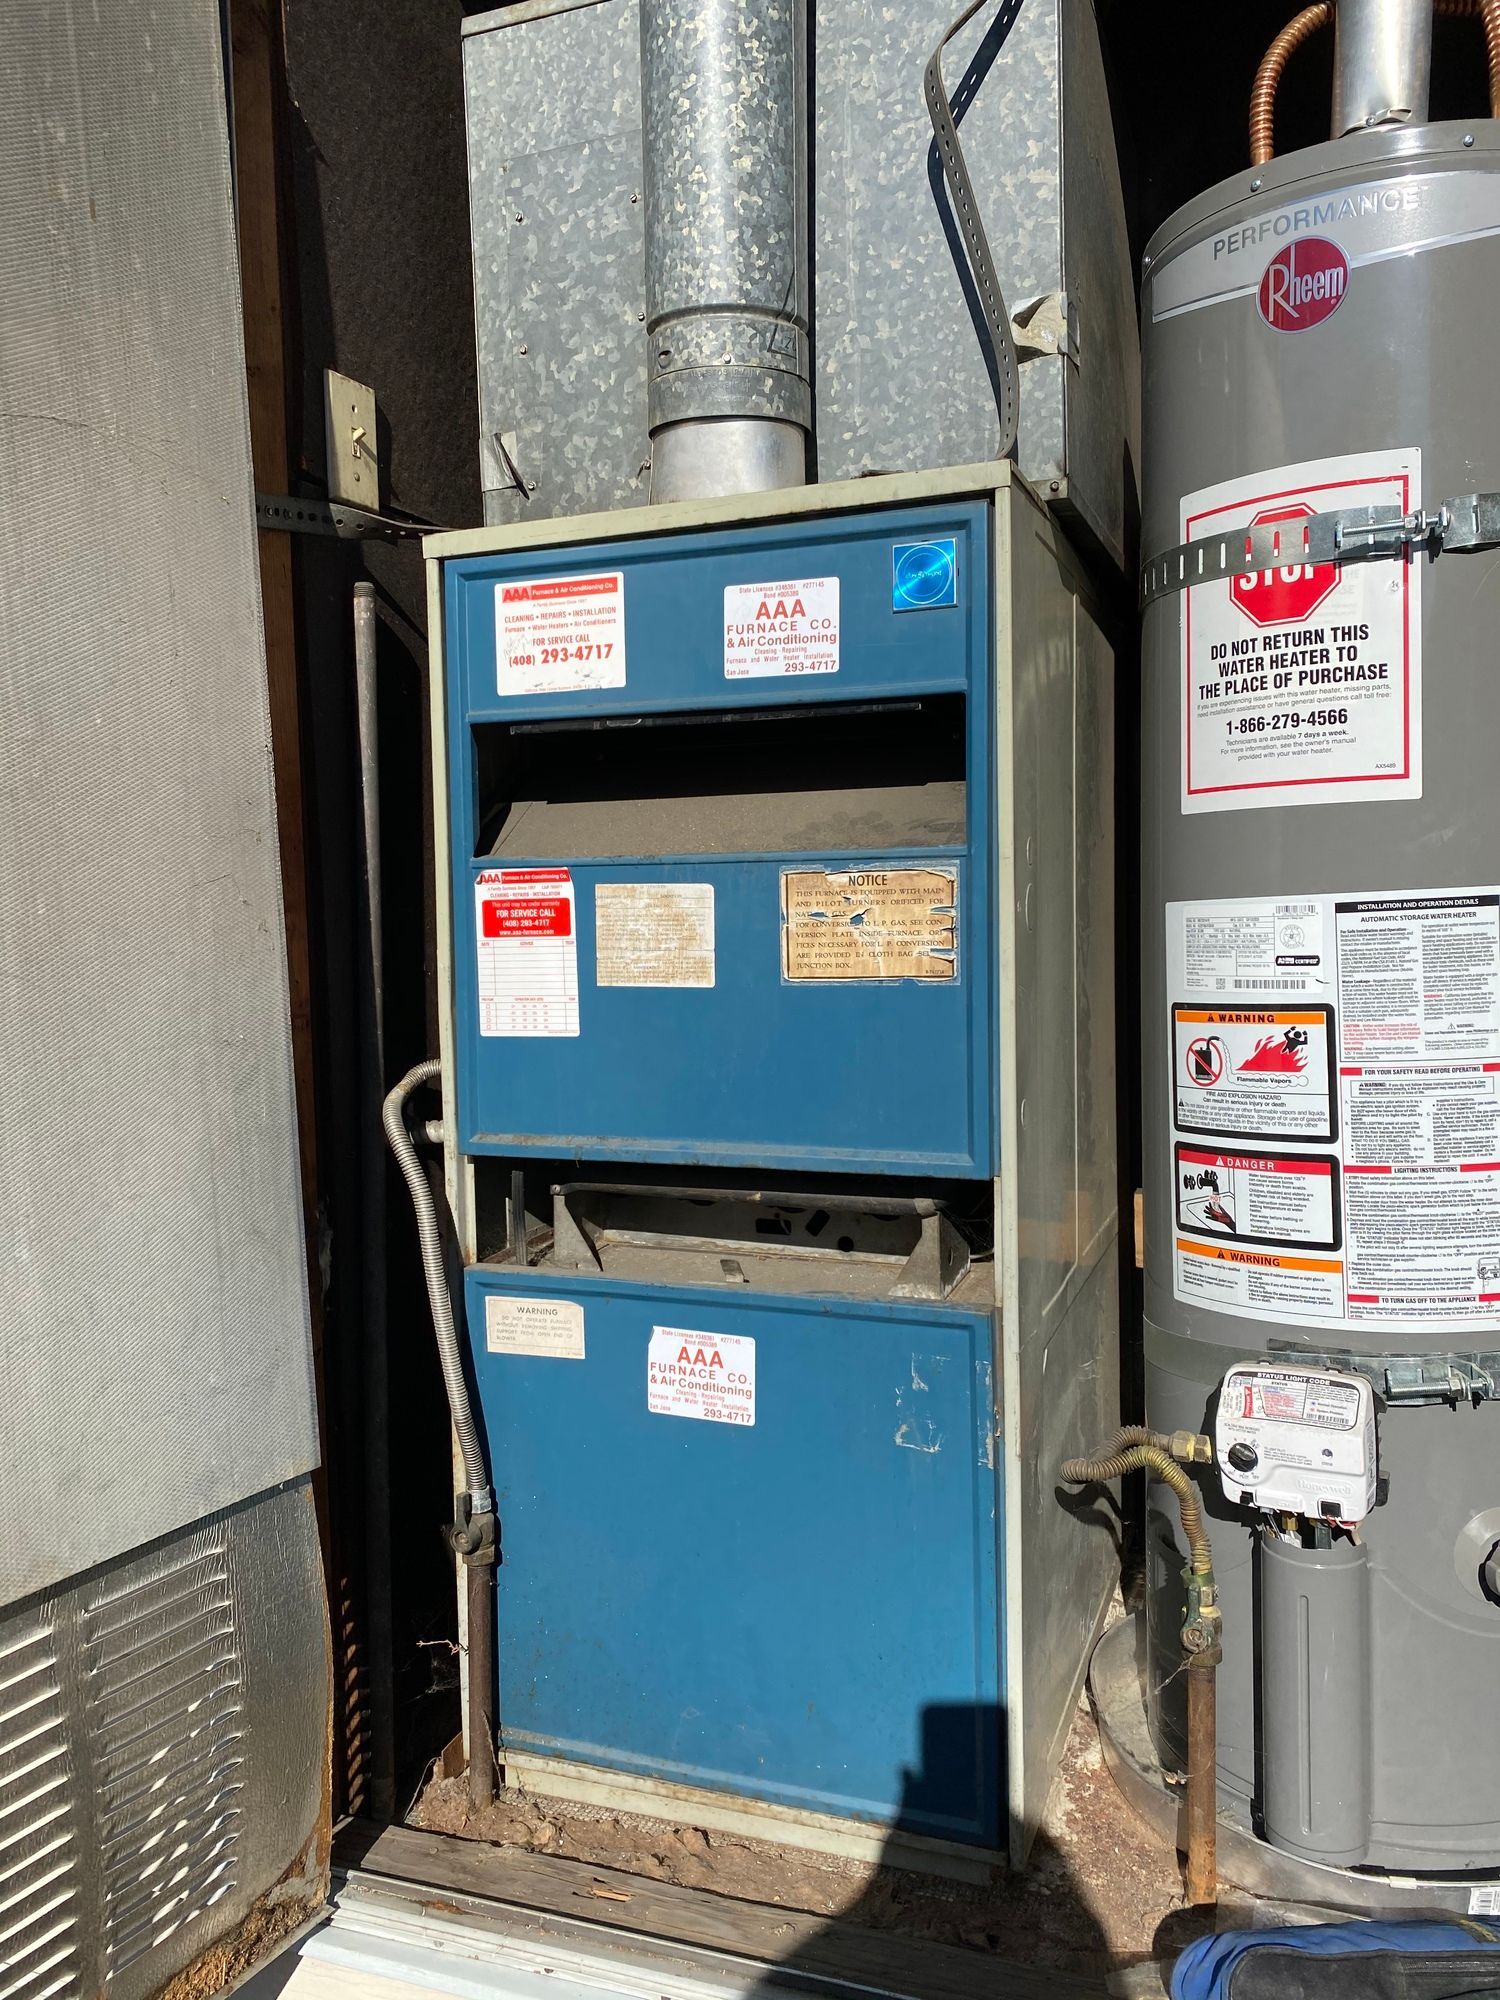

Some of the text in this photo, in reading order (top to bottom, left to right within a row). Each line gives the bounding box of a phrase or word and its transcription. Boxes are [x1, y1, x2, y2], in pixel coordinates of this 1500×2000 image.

[1214, 188, 1421, 260] PERFORMANCE
[1269, 244, 1343, 321] Rheem
[503, 588, 531, 602] AAA
[569, 583, 604, 592] Conditioning
[505, 607, 616, 623] CLEANING REPAIRS INSTALLATION
[756, 599, 806, 620] AAA
[583, 618, 616, 627] Conditioners
[727, 618, 837, 635] FURNACE CO.
[533, 634, 590, 646] FOR SERVICE CALL
[727, 633, 837, 649] & Air Conditioning
[1211, 624, 1369, 660] DO NOT RETURN THIS
[509, 644, 613, 668] (408) 293-4717
[1219, 646, 1358, 678] WATER HEATER TO
[785, 660, 836, 672] 293-4717
[1199, 663, 1388, 700] THE PLACE OF PURCHASE
[1219, 697, 1252, 707] experiencing
[1320, 687, 1342, 695] heater,
[1226, 709, 1348, 735] 1-866-279-4566
[1226, 737, 1257, 746] Technicians
[1270, 733, 1296, 741] available
[1245, 743, 1278, 752] information,
[1305, 738, 1330, 746] owner's
[1331, 737, 1356, 745] manual
[1238, 753, 1262, 762] provided
[480, 873, 501, 884] AAA
[849, 875, 888, 886] NOTICE
[496, 909, 556, 918] FOR SERVICE CALL
[1358, 902, 1402, 910] INSTALLATION
[1219, 1014, 1275, 1023] WARNING
[1227, 1158, 1275, 1170] DANGER
[1230, 1252, 1280, 1267] WARNING
[517, 1307, 558, 1316] WARNING
[677, 1347, 723, 1369] AAA
[650, 1362, 752, 1385] FURNACE CO.
[1257, 1372, 1284, 1380] STATUS
[1286, 1375, 1307, 1383] LIGHT
[650, 1375, 752, 1400] & Air Conditioning
[704, 1408, 751, 1423] 293-4717
[1297, 1481, 1352, 1495] Honeywell
